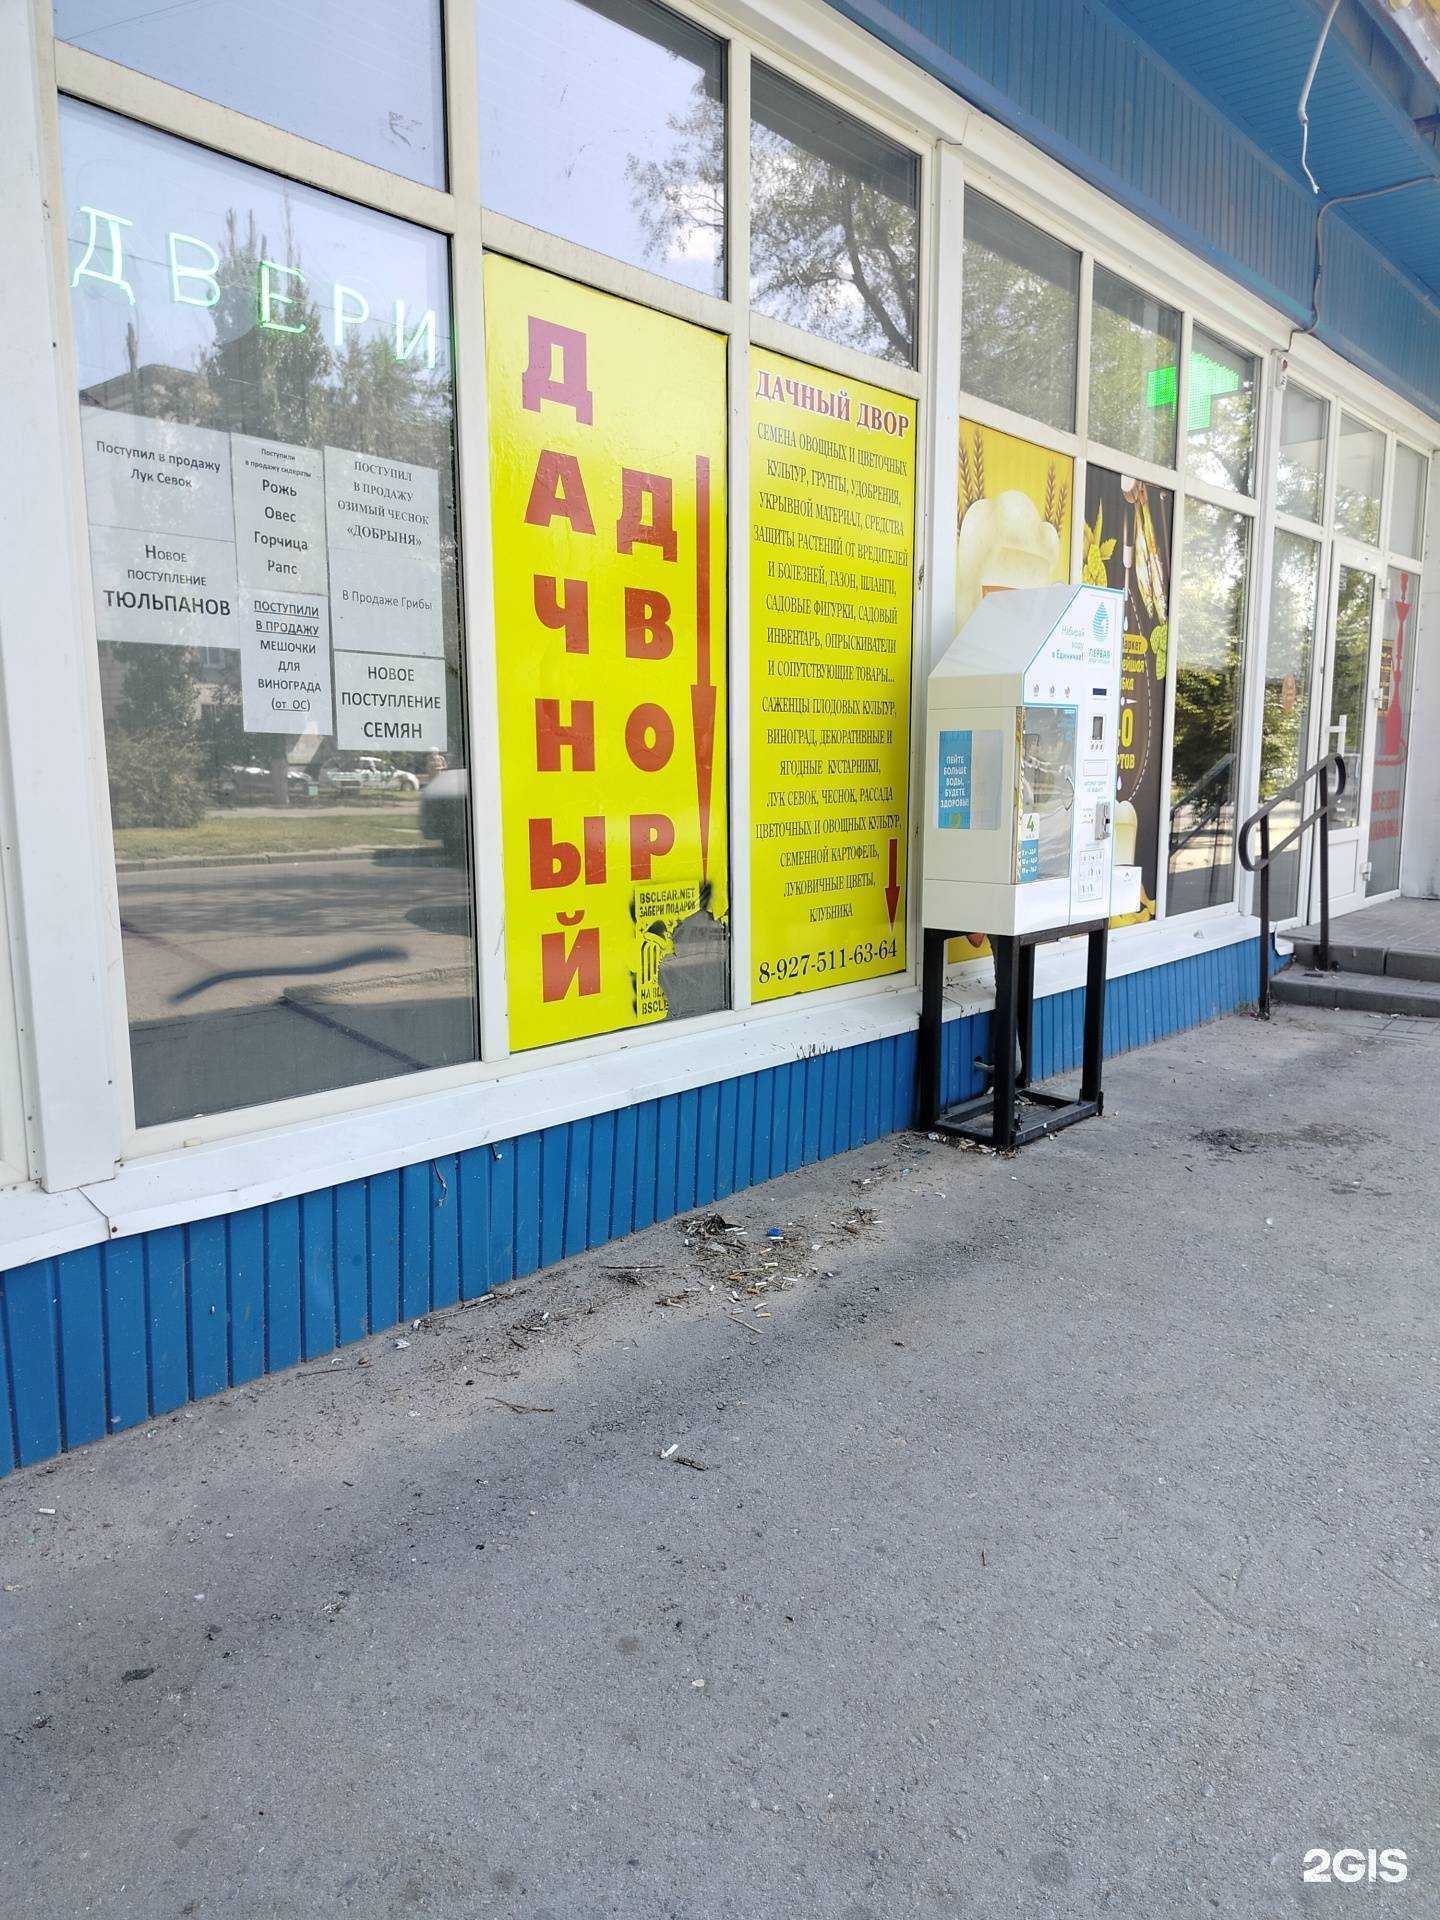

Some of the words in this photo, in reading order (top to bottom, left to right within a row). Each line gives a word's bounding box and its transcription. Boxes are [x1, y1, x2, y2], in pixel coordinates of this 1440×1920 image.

[69, 206, 436, 370] ДВЕРИ
[755, 370, 850, 422] ДАЧНЫЙ
[857, 398, 910, 439] ДВОР
[95, 440, 155, 462] Поступил
[158, 453, 166, 462] в
[168, 453, 221, 474] продажу
[261, 448, 296, 461] Поступили
[757, 422, 796, 448] СЕМЕНА
[799, 433, 847, 461] ОВОЩНЫХ
[849, 447, 855, 462] И
[857, 449, 908, 477] ЦВЕТОЧНЫХ
[129, 468, 154, 483] Лук
[156, 472, 192, 488] Севок
[250, 462, 280, 474] продажу
[354, 461, 412, 482] ПОСТУПИЛ
[262, 479, 297, 498] Рожь
[353, 481, 361, 491] В
[362, 483, 414, 502] ПРОДАЖУ
[766, 459, 809, 485] КУЛЬТУР,
[811, 470, 848, 493] ГРУНТЫ,
[851, 480, 901, 506] УДОБРЕНИЯ,
[264, 507, 297, 523] Овес
[337, 499, 385, 517] ОЗИМЫЙ
[387, 508, 429, 526] ЧЕСНОК
[759, 491, 813, 518] УКРЫВНОЙ
[815, 503, 863, 528] МАТЕРИАЛ,
[865, 514, 904, 536] СРЕДСТВА
[253, 532, 308, 552] Горчица
[347, 525, 423, 547] «ДОБРЫНЯ»
[753, 525, 795, 549] ЗАЩИТЫ
[797, 533, 843, 556] РАСТЕНИЙ
[845, 542, 855, 558] ОТ
[857, 543, 909, 567] ВРЕДИТЕЛЕЙ
[127, 568, 207, 586] ПОСТУПЛЕНИЕ
[267, 560, 297, 575] Рапс
[767, 561, 775, 577] И
[778, 562, 828, 585] БОЛЕЗНЕЙ,
[829, 571, 859, 590] ГАЗОН,
[860, 576, 897, 596] ШЛАНГИ,
[103, 590, 231, 617] ТЮЛЬПАНОВ
[253, 601, 319, 618] ПОСТУПИЛИ
[342, 590, 350, 601] В
[351, 592, 399, 608] Продаже
[401, 596, 433, 611] Грибы
[765, 594, 812, 615] САДОВЫЕ
[813, 600, 855, 621] ФИГУРКИ,
[858, 606, 898, 624] САДОВЫЙ
[255, 620, 264, 632] В
[266, 621, 319, 637] ПРОДАЖУ
[260, 640, 316, 654] МЕШОЧКИ
[767, 627, 822, 649] ИНВЕНТАРЬ,
[825, 633, 897, 653] ОПРЫСКИВАТЕЛИ
[1124, 637, 1141, 652] аркет
[278, 660, 301, 673] ДЛЯ
[521, 315, 607, 1004] ДАЧНЫЙ
[367, 666, 414, 682] НОВОЕ
[615, 466, 679, 881] ДВОР
[768, 661, 775, 676] И
[777, 662, 854, 682] СОПУТСТВУЮЩИЕ
[258, 679, 322, 693] ВИНОГРАДА
[271, 698, 287, 711] (от
[291, 698, 311, 712] ОС)
[341, 692, 441, 709] ПОСТУПЛЕНИЕ
[762, 697, 810, 715] САЖЕНЦЫ
[812, 699, 861, 716] ПЛОДОВЫХ
[862, 700, 897, 717] КУЛЬТУР,
[363, 721, 422, 739] СЕМЯН
[767, 728, 818, 748] ВИНОГРАД,
[819, 729, 884, 747] ДЕКОРАТИВНЫЕ
[886, 730, 892, 744] И
[779, 759, 823, 777] ЯГОДНЫЕ
[827, 758, 881, 776] КУСТАРНИКИ,
[946, 755, 964, 764] ПЕЙТЕ
[943, 766, 967, 775] БОЛЬШЕ
[766, 791, 785, 808] ЛУК
[787, 790, 819, 806] СЕВОК,
[821, 789, 857, 806] ЧЕСНОК,
[860, 787, 894, 802] РАССАДА
[945, 788, 965, 797] БУДЕТЕ
[755, 820, 812, 840] ЦВЕТОЧНЫХ
[813, 819, 820, 833] И
[822, 816, 866, 834] ОВОЩНЫХ
[868, 814, 902, 831] КУЛЬТУР,
[1026, 815, 1035, 832] 4
[780, 845, 829, 868] СЕМЕННОЙ
[831, 844, 880, 863] КАРТОФЕЛЬ,
[784, 875, 844, 898] ЛУКОВИЧНЫЕ
[846, 872, 876, 890] ЦВЕТЫ,
[640, 888, 695, 903] BSCLEAR.NET
[640, 904, 664, 917] ЗАБЕРИ
[809, 903, 854, 923] КЛУБНИКА
[759, 937, 898, 985] 8-927-511-63-64
